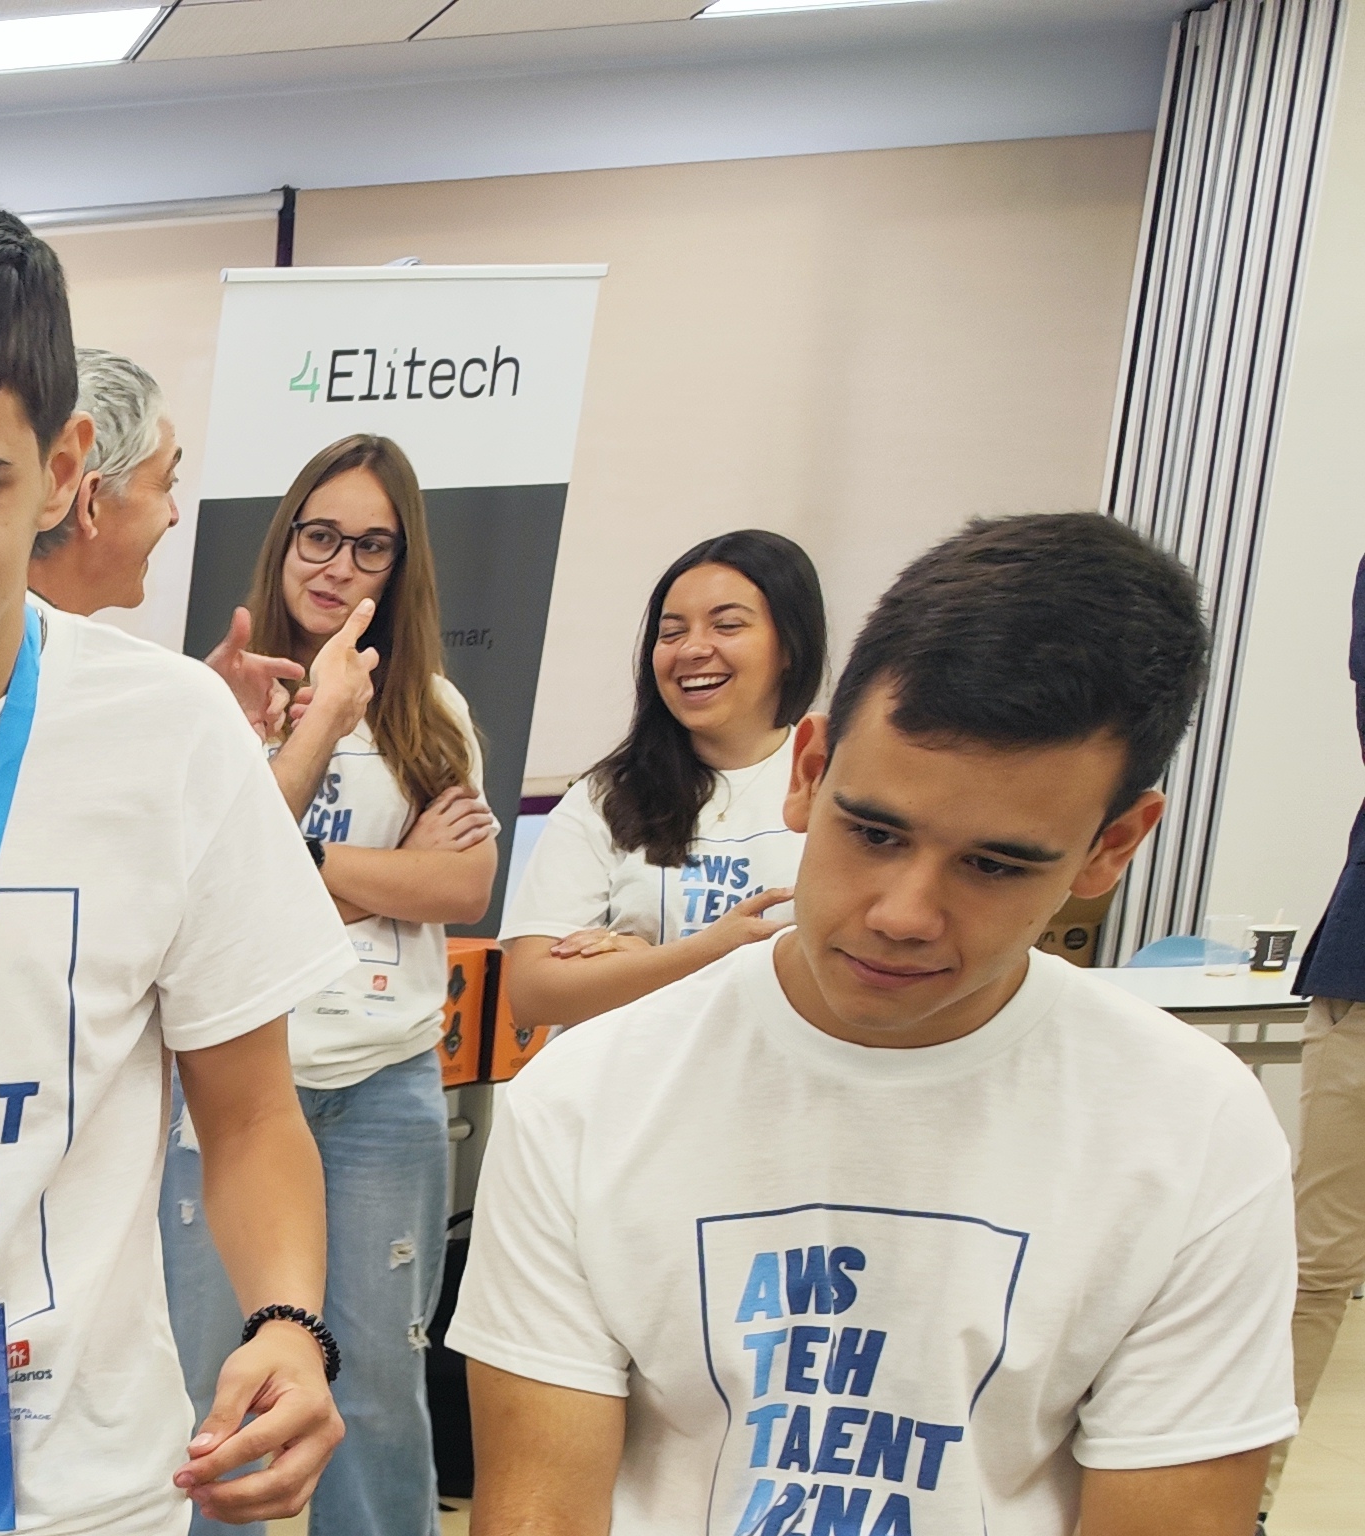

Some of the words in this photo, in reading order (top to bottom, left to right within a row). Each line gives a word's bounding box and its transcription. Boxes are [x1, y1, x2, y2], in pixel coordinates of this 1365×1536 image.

[305, 802, 353, 842] ECH
[679, 854, 750, 890] AWS
[745, 1403, 964, 1491] TAENT
